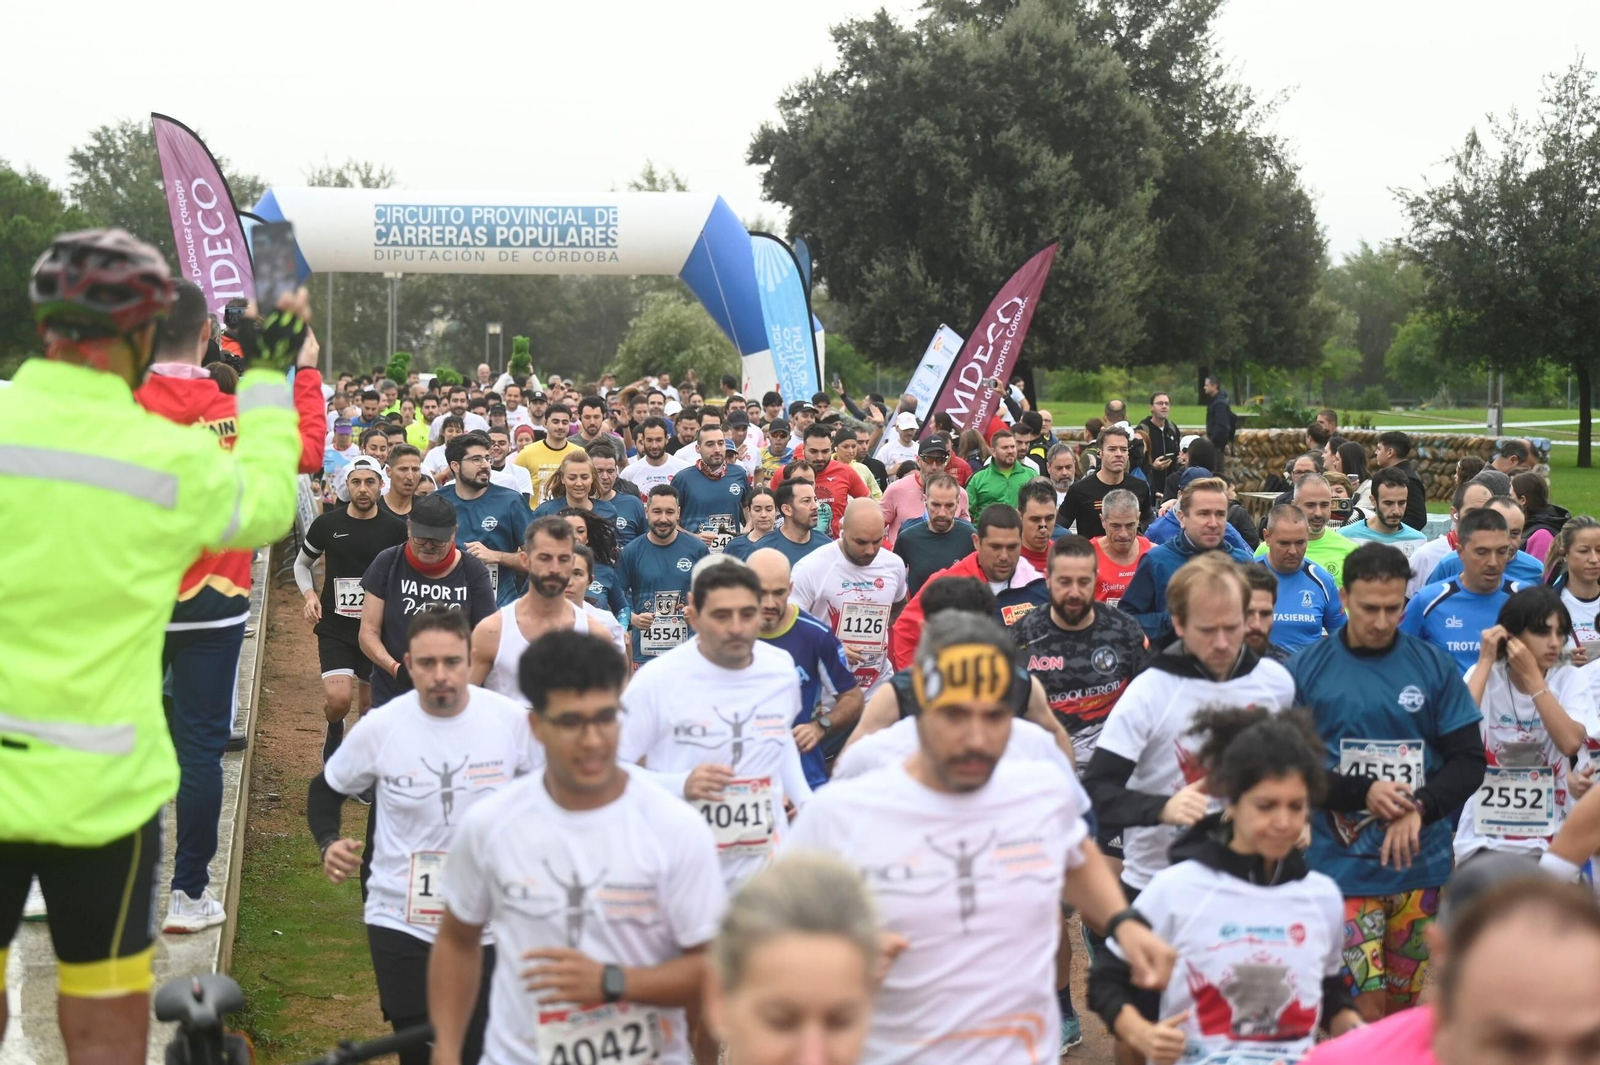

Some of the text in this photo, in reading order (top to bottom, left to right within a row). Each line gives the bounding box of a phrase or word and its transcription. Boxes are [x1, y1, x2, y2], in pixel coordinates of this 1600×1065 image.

[374, 206, 619, 226] CIRCUITO PROVINCIAL DE
[374, 225, 619, 247] CARRERAS POPULARES
[374, 248, 619, 263] DIPUTACIÓN DE CÓRDOBA
[401, 579, 467, 601] VA POR TI
[643, 627, 681, 641] 4554
[843, 616, 883, 634] 1126
[1027, 655, 1064, 671] AON
[1346, 761, 1412, 784] 4553
[1480, 786, 1543, 809] 2552
[549, 1022, 648, 1065] 4042
